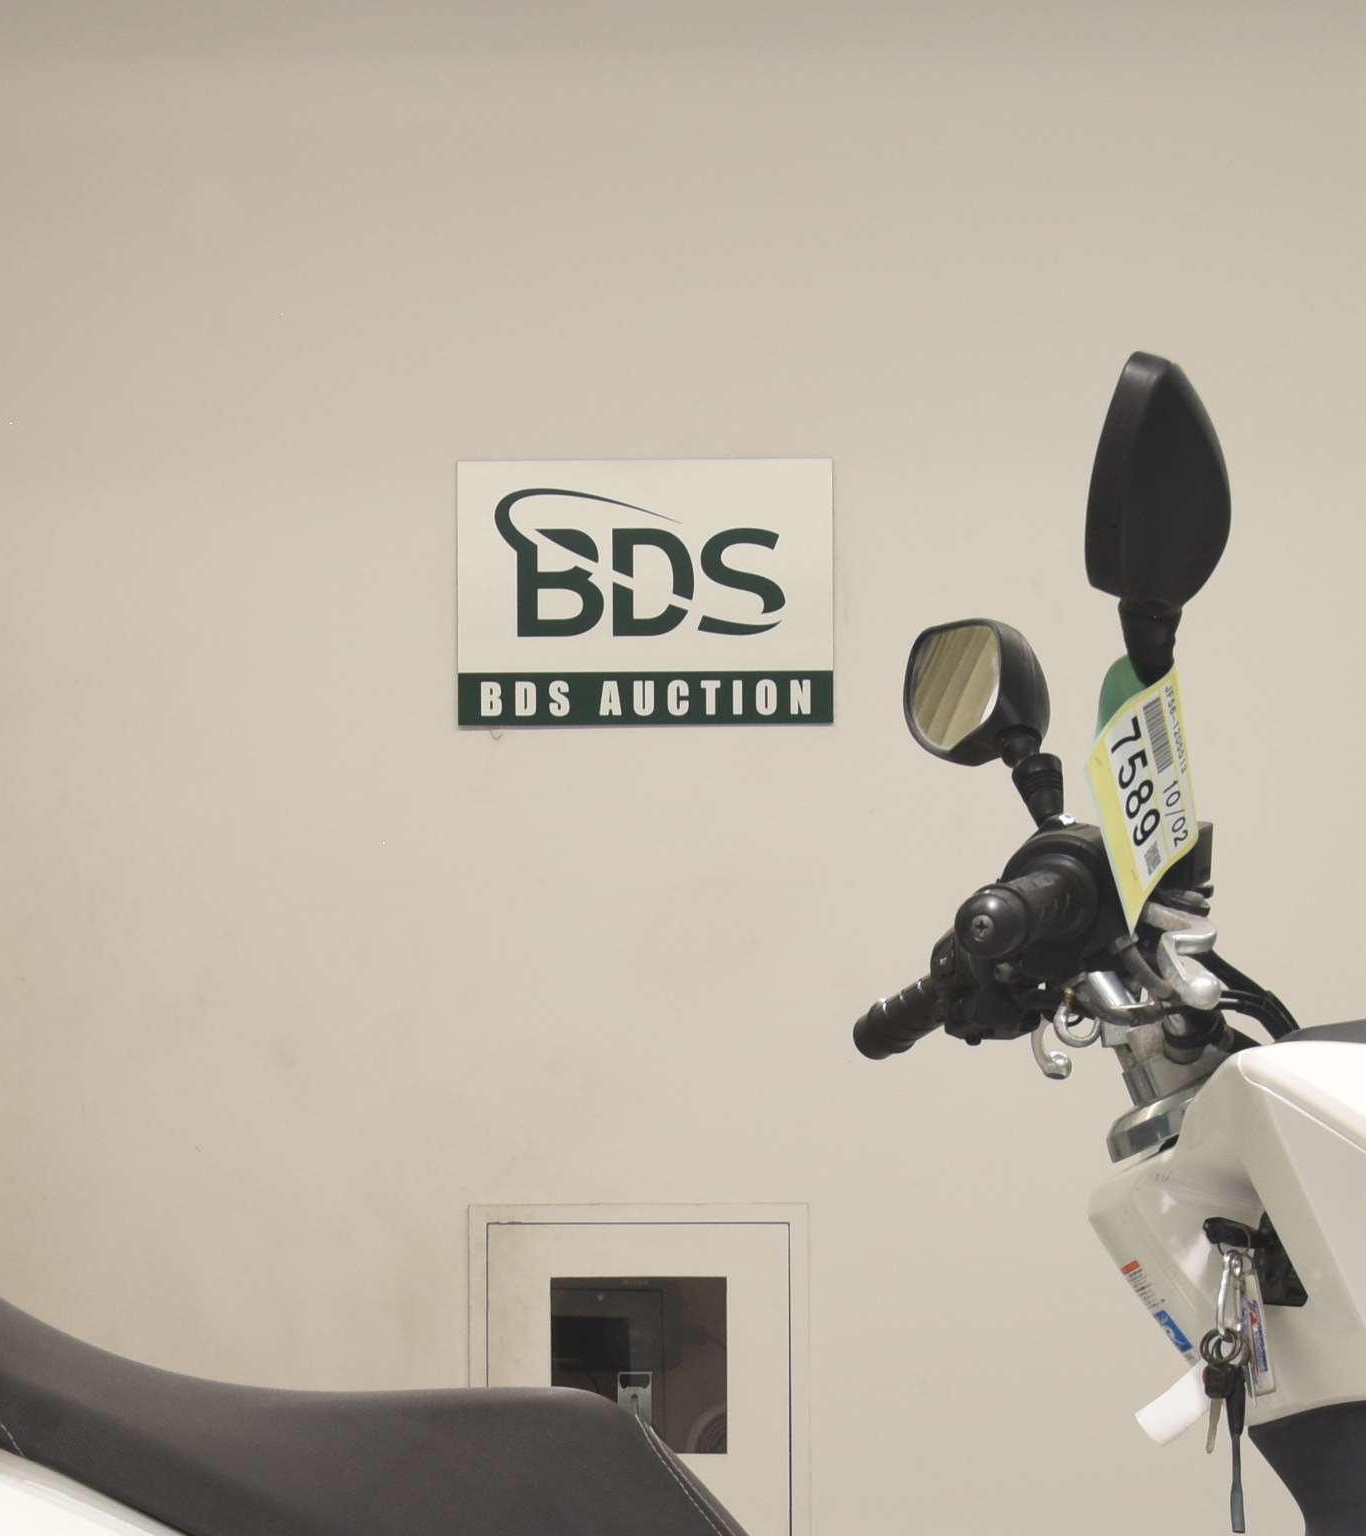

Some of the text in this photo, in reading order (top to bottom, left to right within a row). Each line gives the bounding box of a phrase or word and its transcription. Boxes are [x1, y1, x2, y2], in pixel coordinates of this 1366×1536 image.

[494, 487, 787, 637] BDS
[480, 678, 812, 718] BDS AUCTION
[1110, 715, 1161, 847] 7589
[1162, 780, 1189, 848] 10/02
